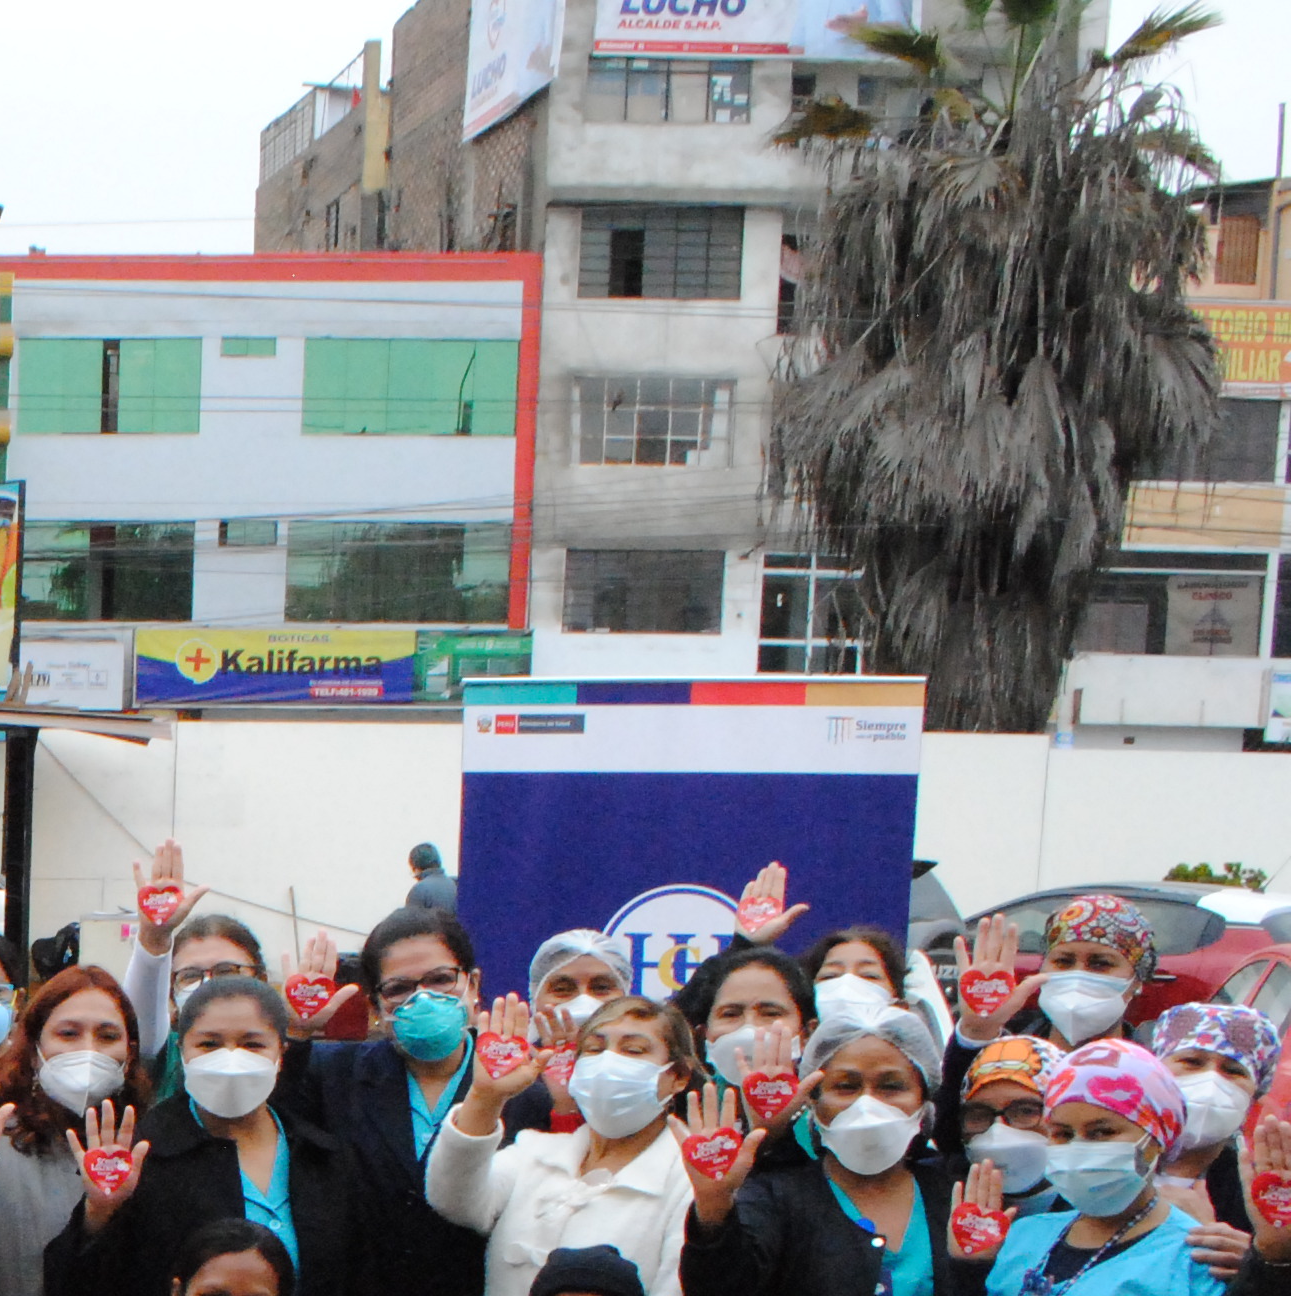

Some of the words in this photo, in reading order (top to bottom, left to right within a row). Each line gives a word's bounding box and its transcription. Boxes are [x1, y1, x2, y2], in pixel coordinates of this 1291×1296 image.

[618, 18, 680, 30] ALCALDE
[683, 20, 722, 31] S.M.P.
[267, 633, 330, 643] BOTICAS
[221, 648, 383, 676] Kalifarma
[855, 719, 907, 733] Siempre
